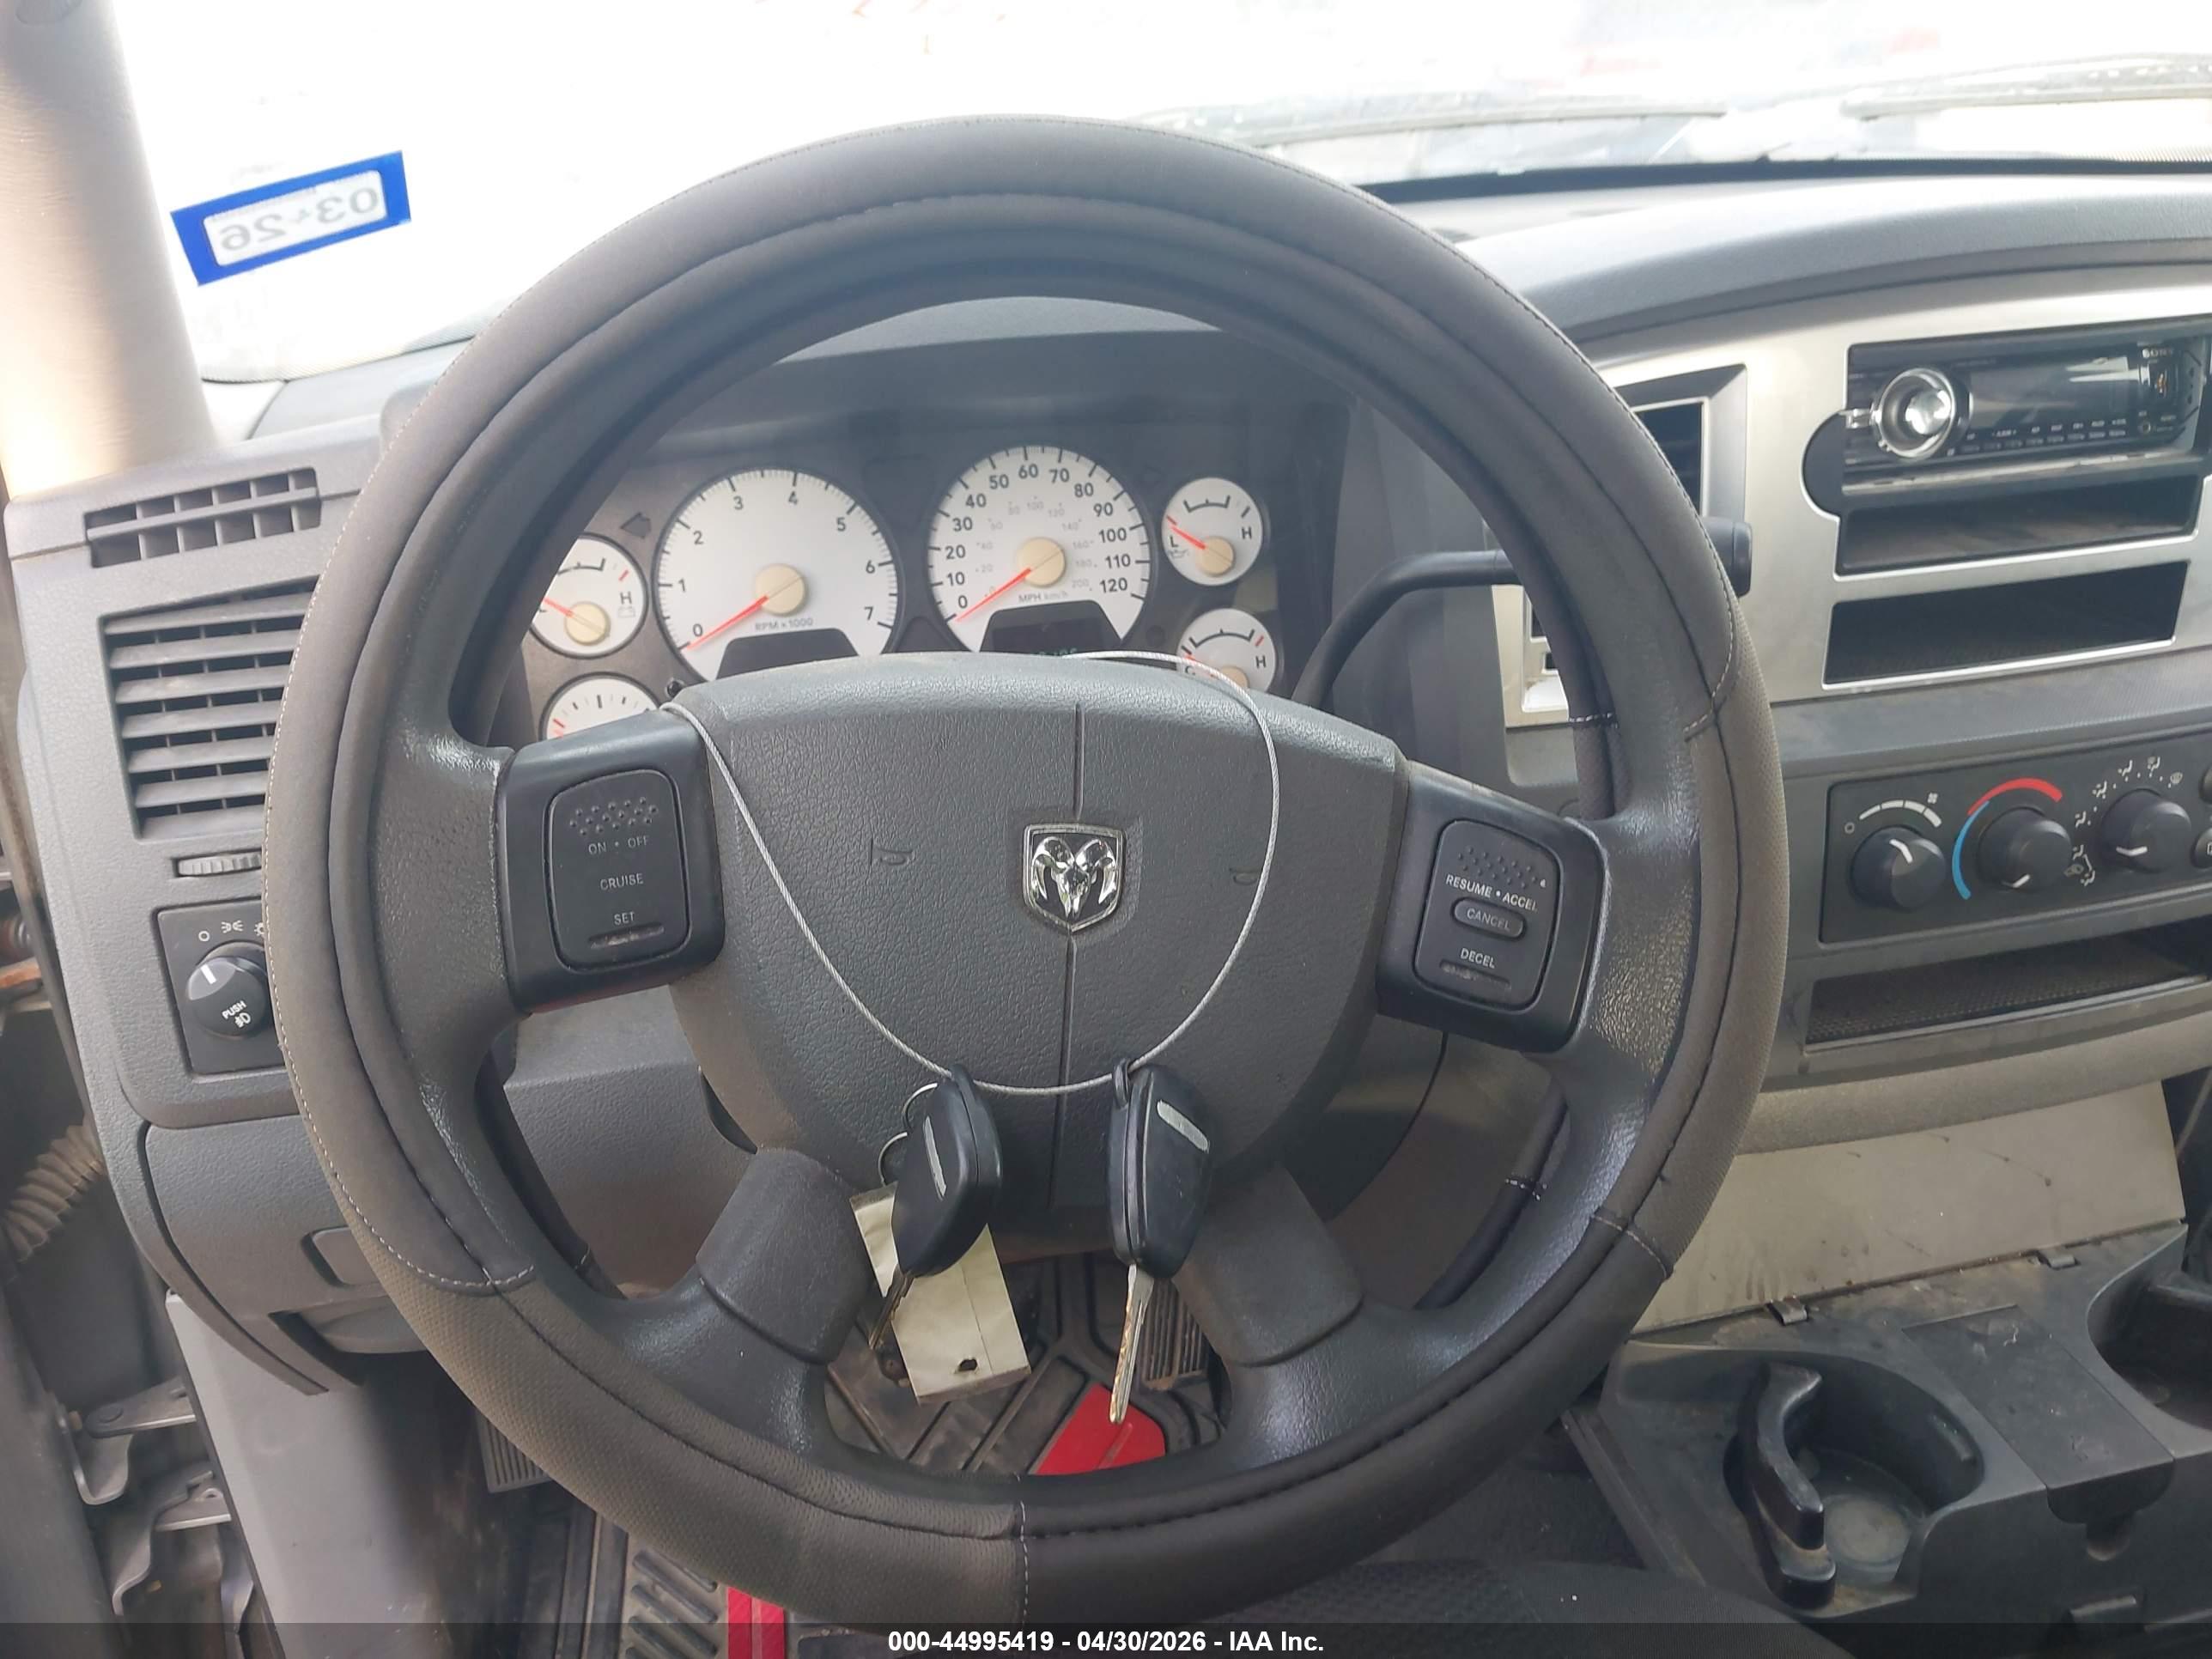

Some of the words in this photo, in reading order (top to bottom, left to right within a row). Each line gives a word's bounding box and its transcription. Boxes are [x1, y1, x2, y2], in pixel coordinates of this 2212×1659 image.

[1018, 464, 1039, 479] 60
[1048, 468, 1070, 483] 70
[989, 474, 1009, 489] 50
[788, 491, 799, 505] 4
[1074, 483, 1094, 498] 80
[733, 495, 744, 510] 3
[965, 493, 987, 508] 40
[1093, 502, 1113, 517] 90
[836, 517, 847, 532] 5
[952, 517, 973, 532] 30
[693, 531, 703, 544] 2
[1099, 527, 1127, 543] 100
[1242, 526, 1252, 539] H
[1170, 535, 1179, 548] L
[945, 544, 966, 560] 20
[866, 560, 876, 574] 6
[1105, 553, 1131, 568] 110
[678, 579, 686, 592] 1
[946, 571, 965, 586] 10
[1100, 577, 1127, 593] 120
[619, 591, 632, 605] H
[957, 595, 968, 609] 0
[1018, 592, 1042, 603] MPH
[864, 606, 873, 620] 7
[692, 623, 703, 637] 0
[755, 622, 779, 630] RPM
[788, 618, 813, 627] 1000
[1255, 655, 1267, 668] H
[588, 842, 607, 855] ON
[628, 836, 649, 849] OFF
[600, 872, 644, 890] CRUISE
[1445, 873, 1492, 898] RESUME
[1503, 892, 1539, 913] ACCEL
[614, 911, 635, 926] SET
[1467, 908, 1511, 932] CANCEL
[1461, 947, 1497, 969] DECEL
[222, 1000, 247, 1020] PUSH
